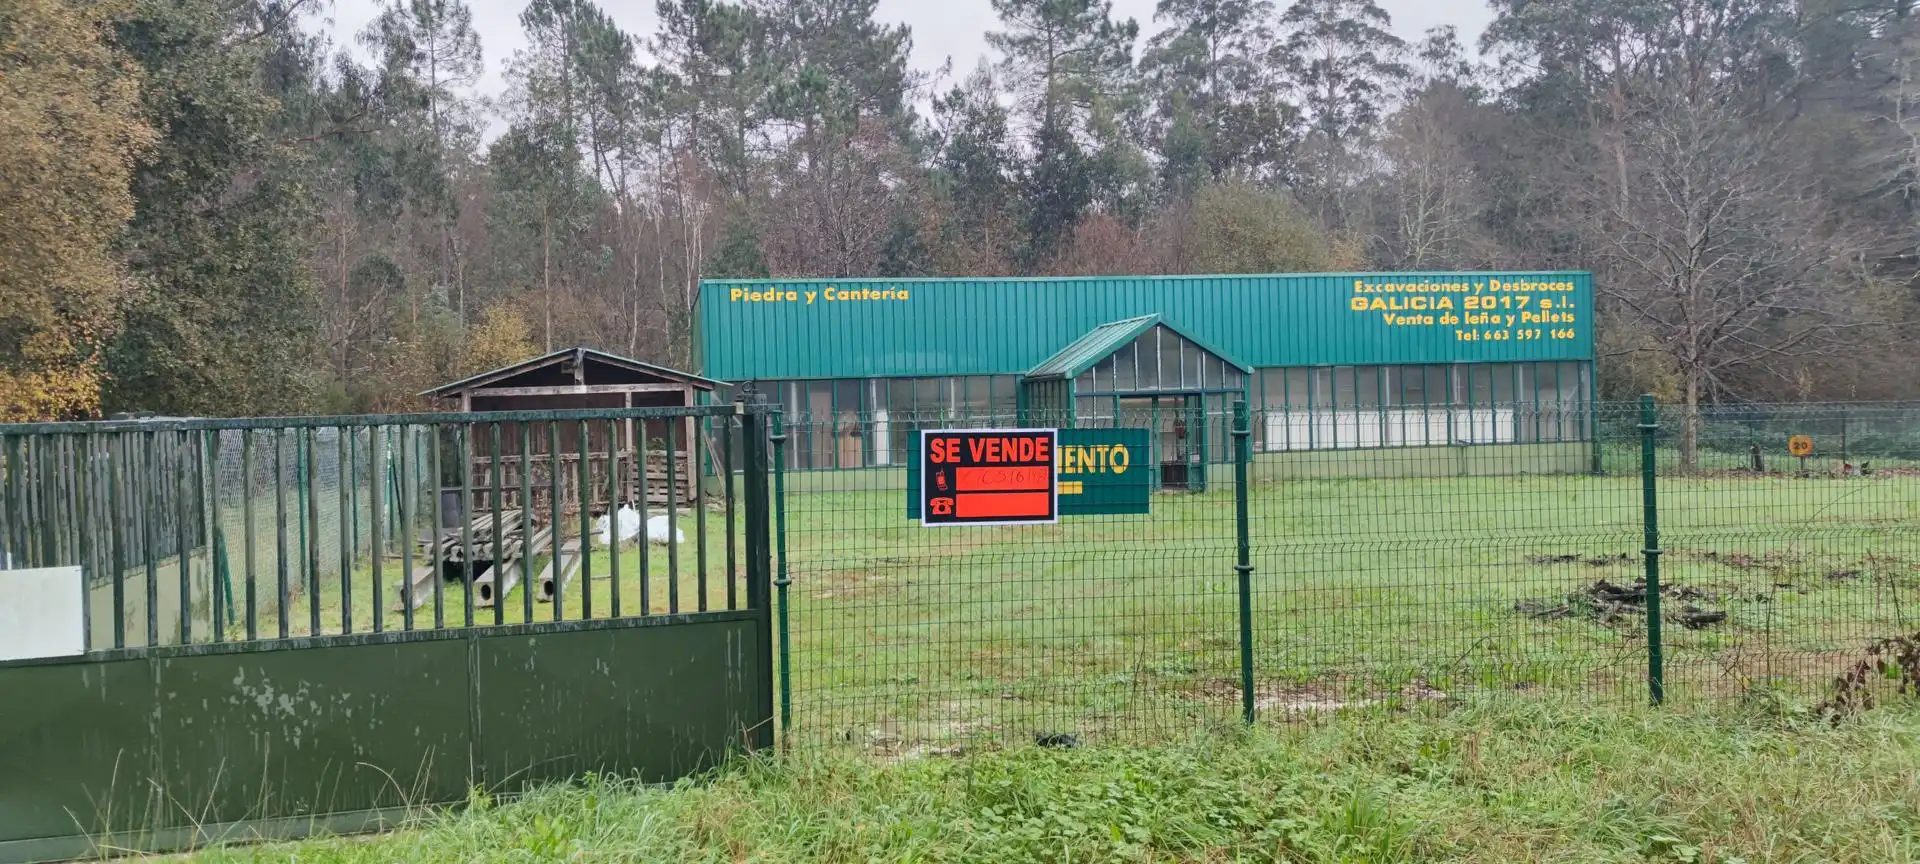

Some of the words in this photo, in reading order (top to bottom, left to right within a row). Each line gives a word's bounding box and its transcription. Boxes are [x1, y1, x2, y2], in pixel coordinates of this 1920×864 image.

[1354, 280, 1469, 293] Excavaciones
[1474, 282, 1485, 295] y
[1489, 279, 1574, 292] Desbroces
[730, 288, 798, 302] Piedra
[804, 290, 817, 304] y
[823, 287, 909, 301] Cantería
[1351, 296, 1453, 311] GALICIA
[1464, 296, 1530, 310] 2017
[1383, 312, 1434, 325] Venta
[1439, 312, 1459, 325] de
[1465, 311, 1501, 325] leña
[1506, 313, 1516, 327] y
[1521, 310, 1575, 324] Pellets
[1484, 329, 1510, 340] 663
[1517, 329, 1542, 340] 597
[1550, 328, 1575, 339] 166
[930, 438, 961, 464] SE
[968, 437, 1049, 463] VENDE
